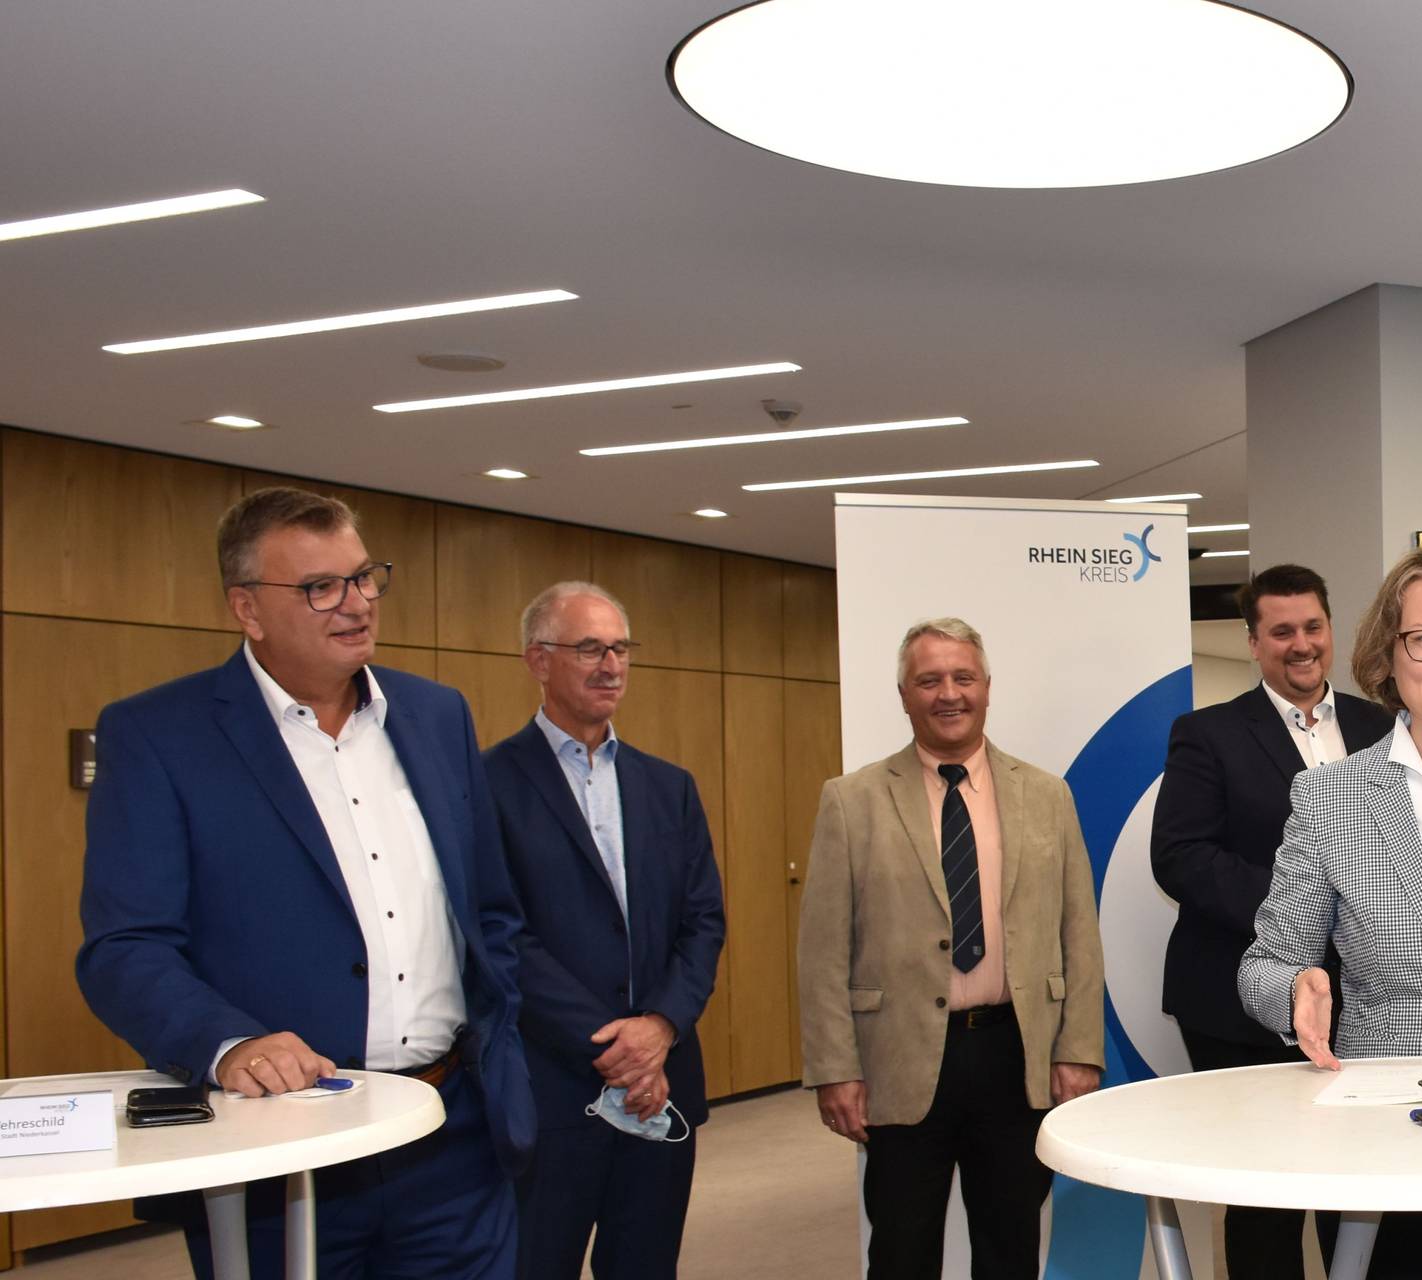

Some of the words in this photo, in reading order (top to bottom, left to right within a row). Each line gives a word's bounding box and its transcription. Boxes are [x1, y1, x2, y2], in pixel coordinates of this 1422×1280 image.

[1029, 547, 1086, 563] RHEIN
[1091, 548, 1132, 565] SIEG
[1079, 566, 1128, 583] KREIS
[0, 1116, 65, 1131] ehreschild
